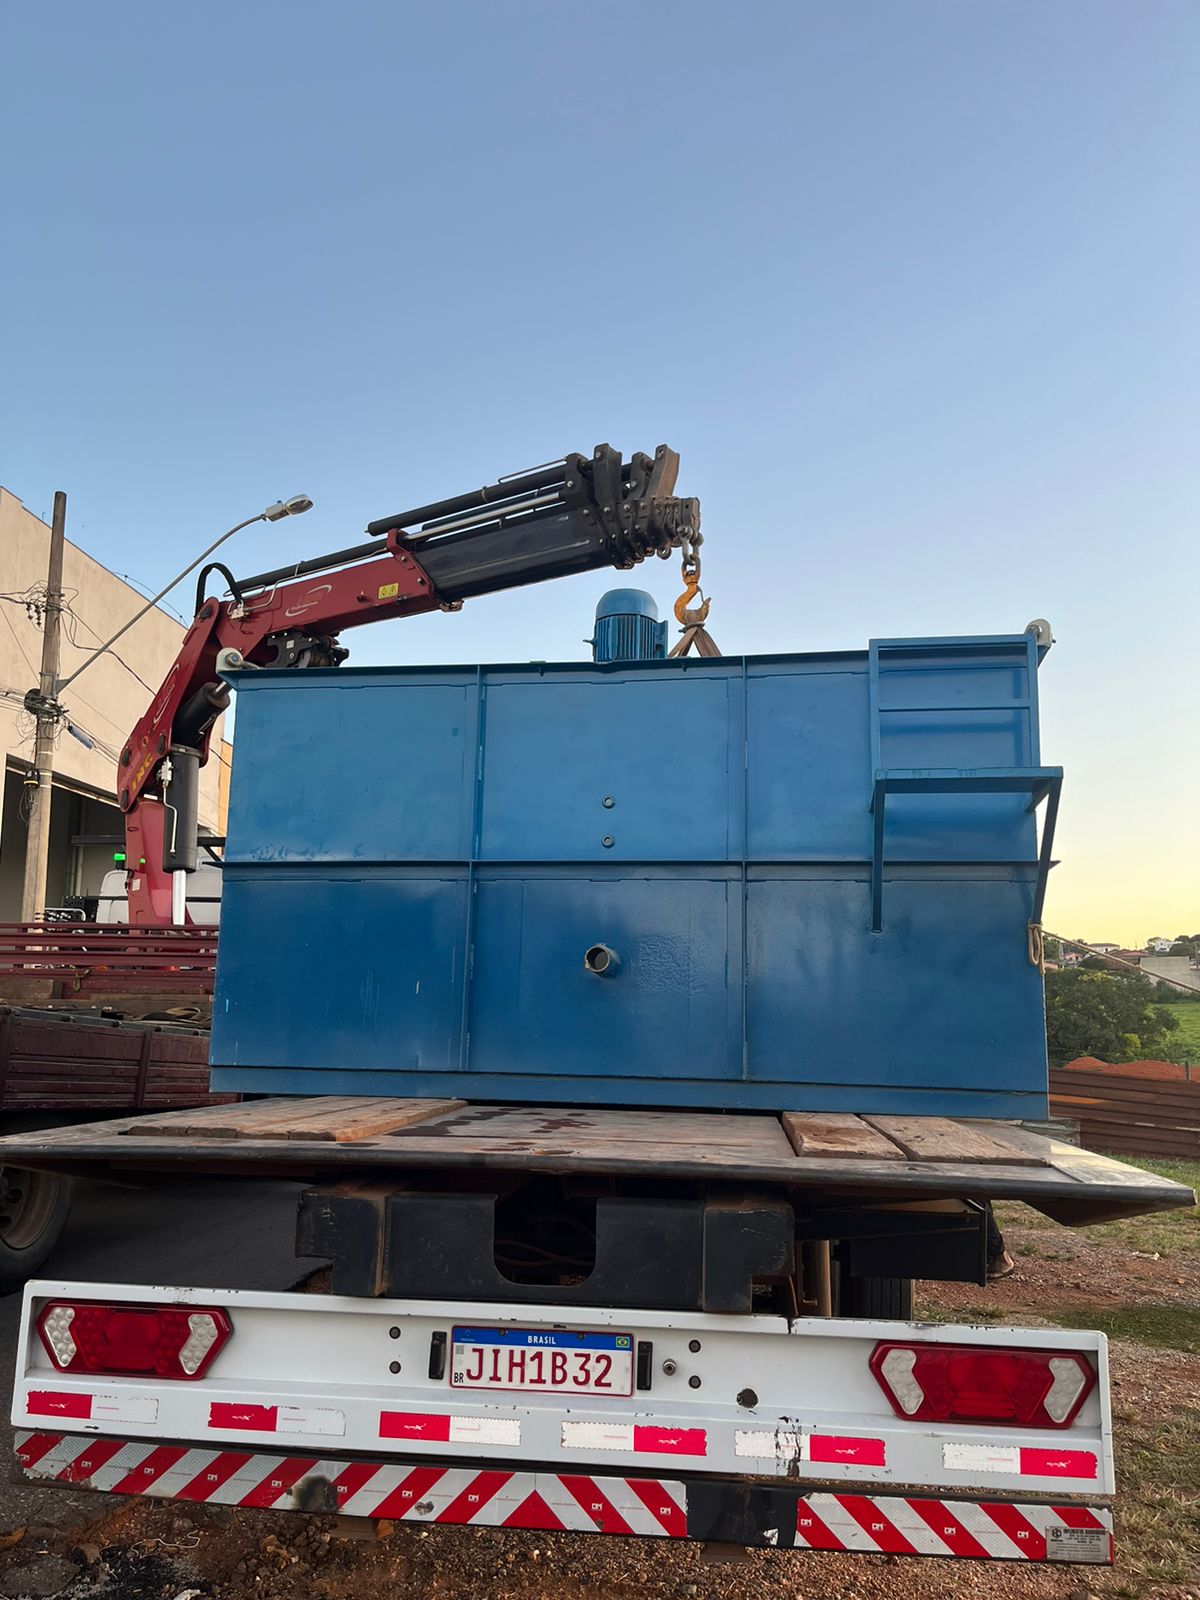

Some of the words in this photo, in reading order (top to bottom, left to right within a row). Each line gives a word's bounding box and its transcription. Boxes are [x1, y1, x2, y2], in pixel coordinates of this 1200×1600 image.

[527, 1335, 556, 1345] BRASIL
[466, 1347, 612, 1388] JIH1B32
[453, 1371, 464, 1384] BR
